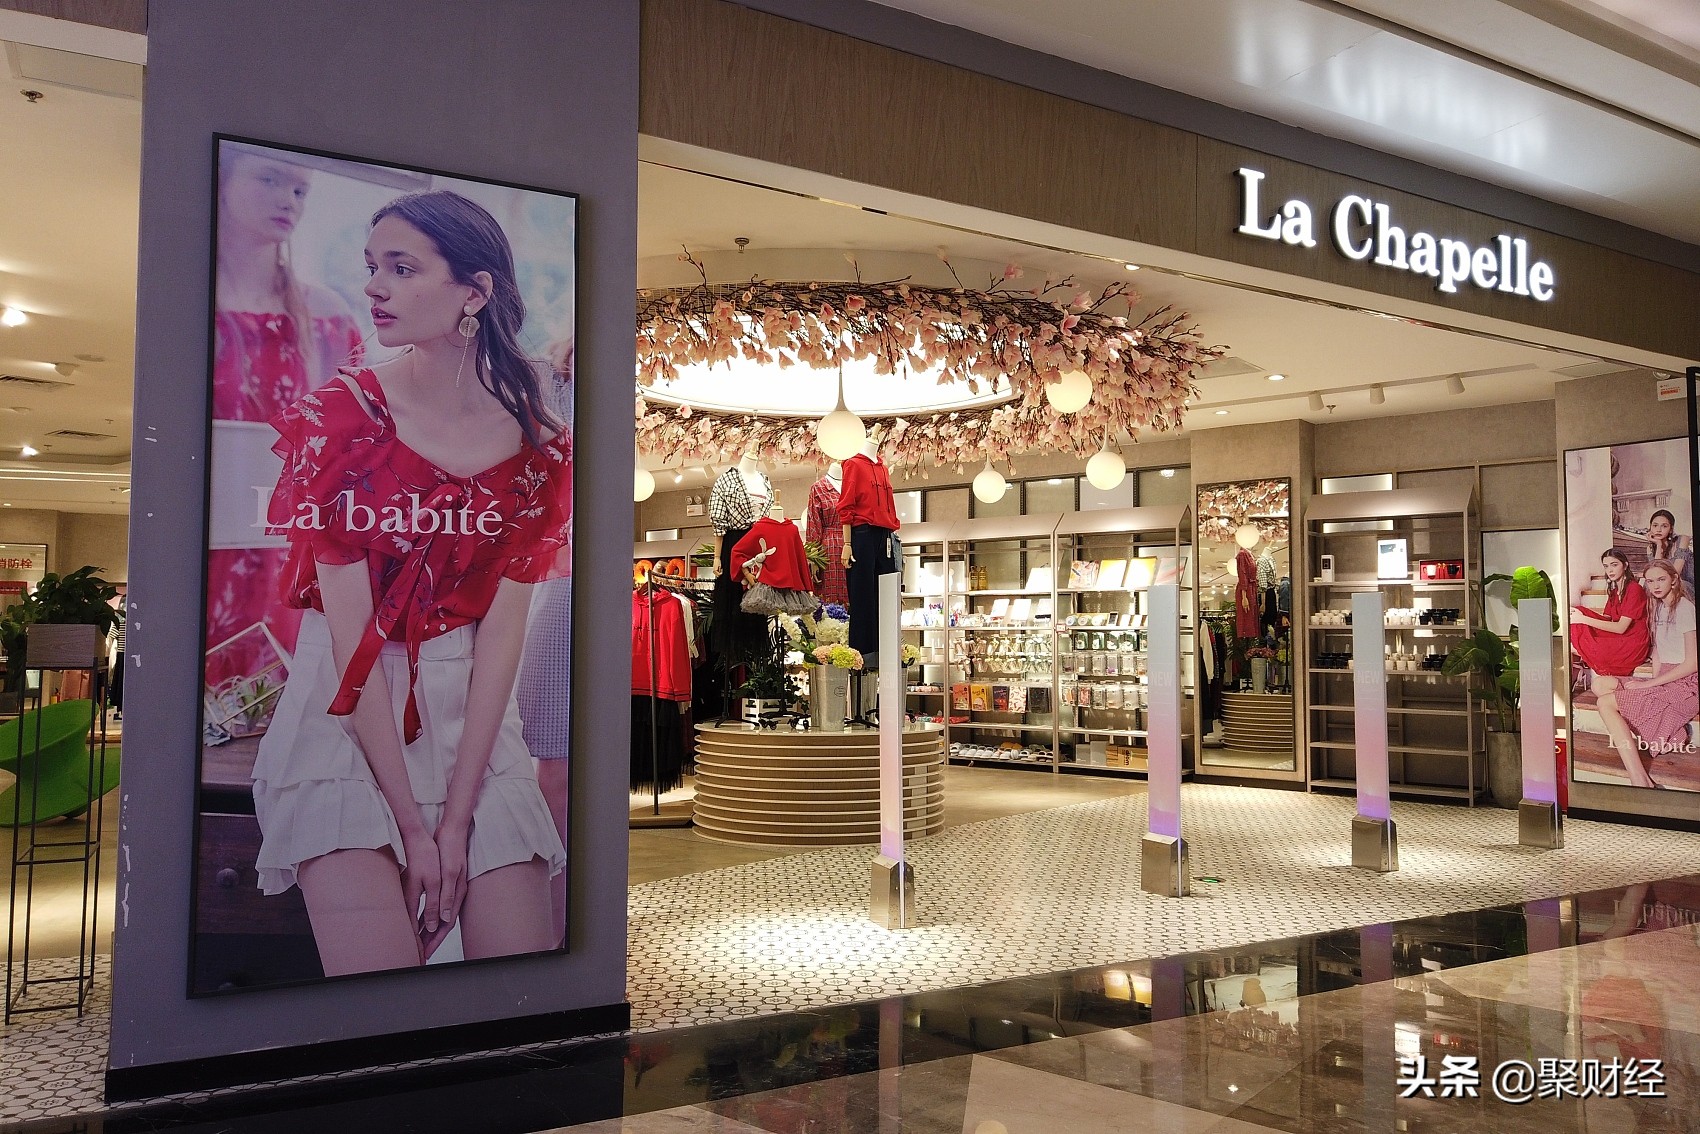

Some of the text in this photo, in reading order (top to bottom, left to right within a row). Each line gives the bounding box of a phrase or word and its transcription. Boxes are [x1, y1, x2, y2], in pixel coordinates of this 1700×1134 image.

[1238, 168, 1555, 302] La Chapelle
[251, 485, 503, 537] La babité
[1151, 671, 1173, 687] NEW
[1357, 670, 1380, 684] NEW
[1523, 668, 1547, 681] NEW
[1607, 733, 1697, 754] La babité
